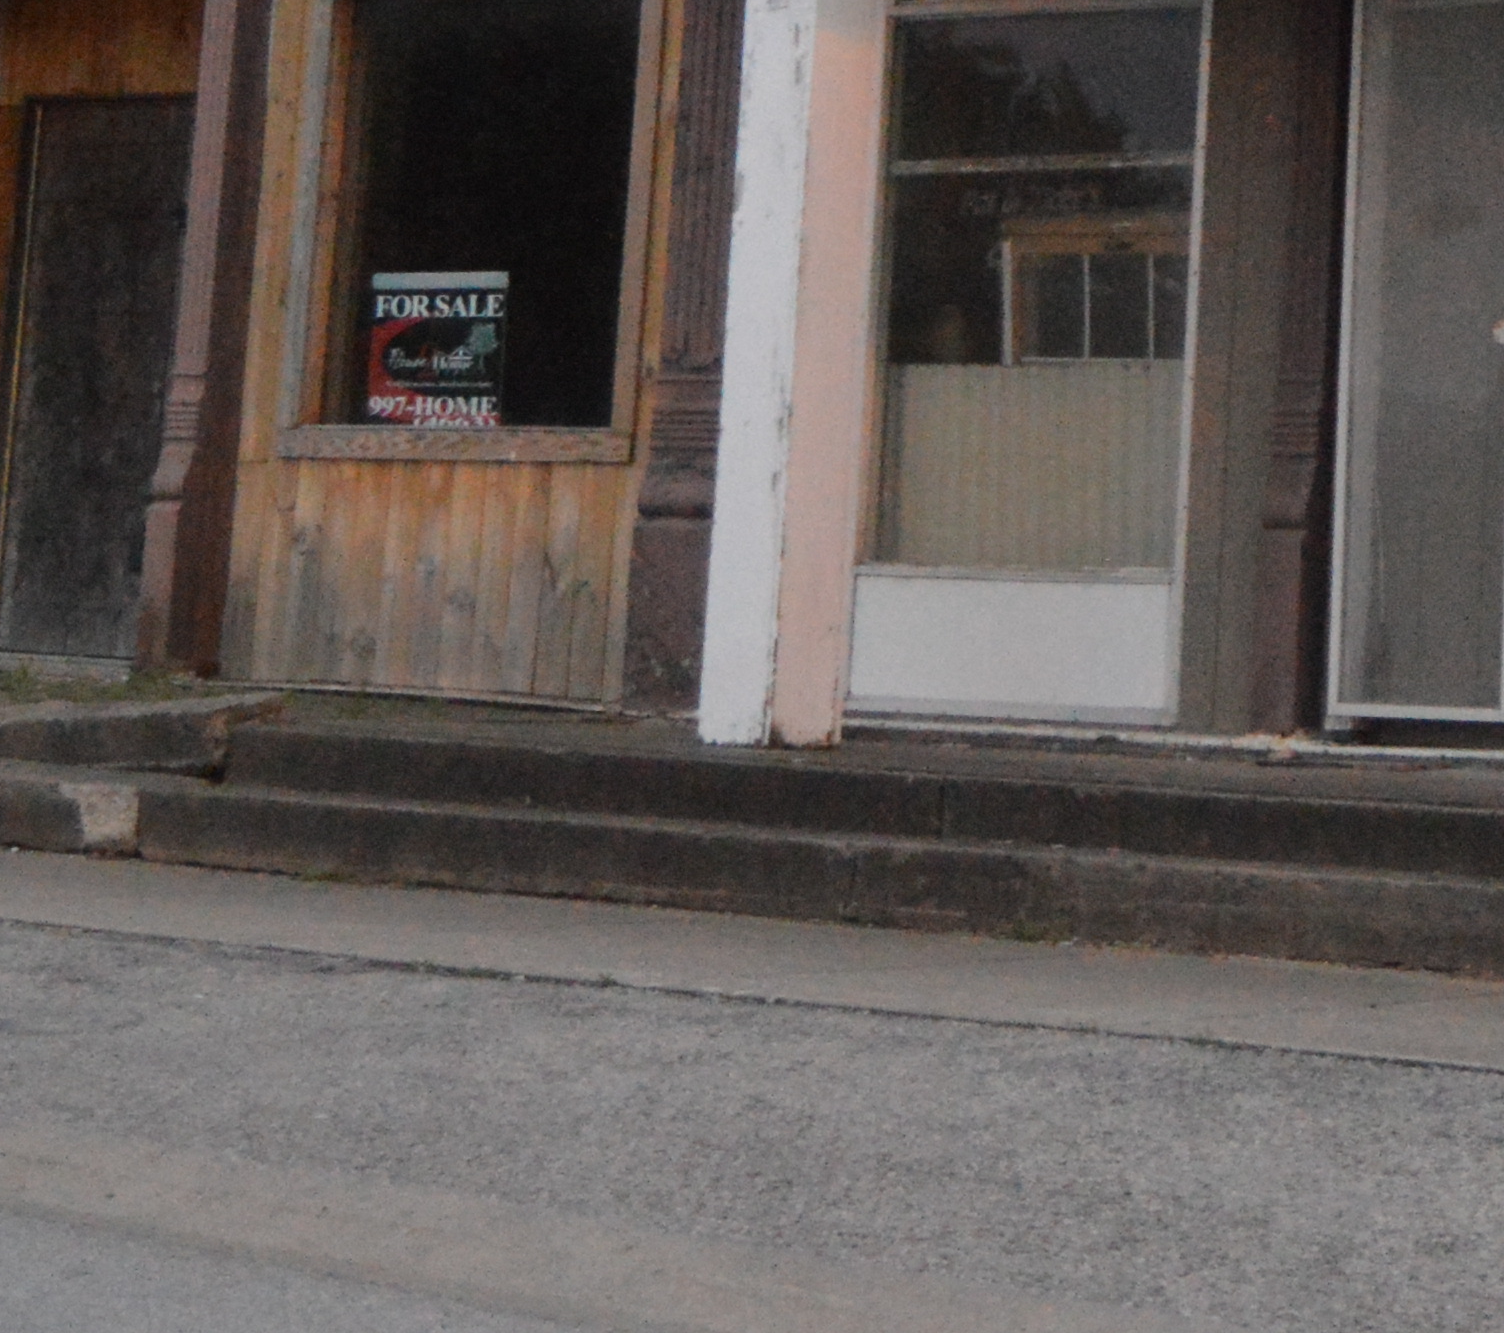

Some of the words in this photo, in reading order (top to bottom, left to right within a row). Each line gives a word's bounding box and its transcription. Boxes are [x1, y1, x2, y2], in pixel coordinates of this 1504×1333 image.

[375, 294, 430, 318] FOR
[433, 294, 504, 318] SALE
[368, 396, 497, 417] 997-HOME
